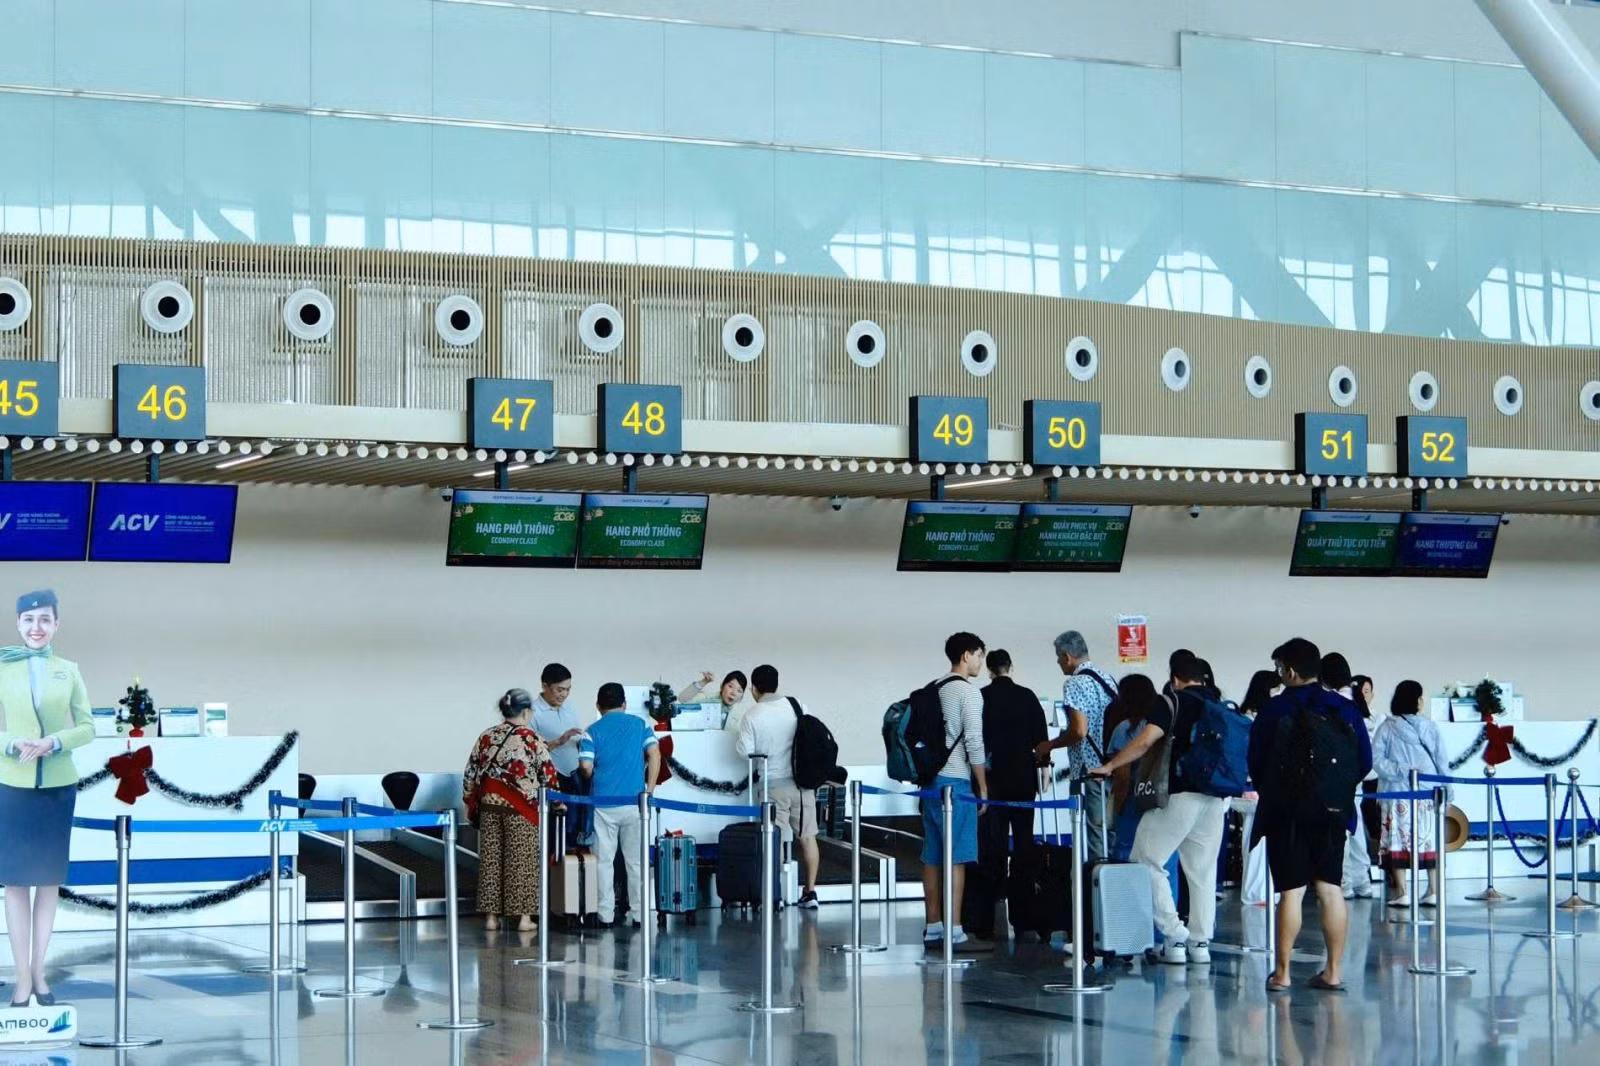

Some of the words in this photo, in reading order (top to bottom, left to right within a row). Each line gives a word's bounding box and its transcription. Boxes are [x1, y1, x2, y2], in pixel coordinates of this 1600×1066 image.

[136, 384, 188, 421] 46
[491, 397, 537, 432] 47
[621, 401, 666, 436] 48
[933, 413, 974, 447] 49
[1048, 417, 1087, 449] 50
[1321, 429, 1353, 461] 51
[1421, 431, 1456, 462] 52
[108, 514, 161, 531] ACV
[475, 522, 502, 536] HẠNG
[503, 519, 522, 534] PHỔ
[524, 521, 555, 535] THÔNG
[605, 525, 630, 539] HẠNG
[631, 522, 650, 536] PHỔ
[652, 523, 682, 537] THÔNG
[925, 531, 948, 544] HẠNG
[949, 528, 967, 542] PHỔ
[968, 529, 996, 542] THÔNG
[491, 537, 520, 545] ECONOMY
[520, 537, 538, 545] CLASS
[259, 820, 287, 832] ACV
